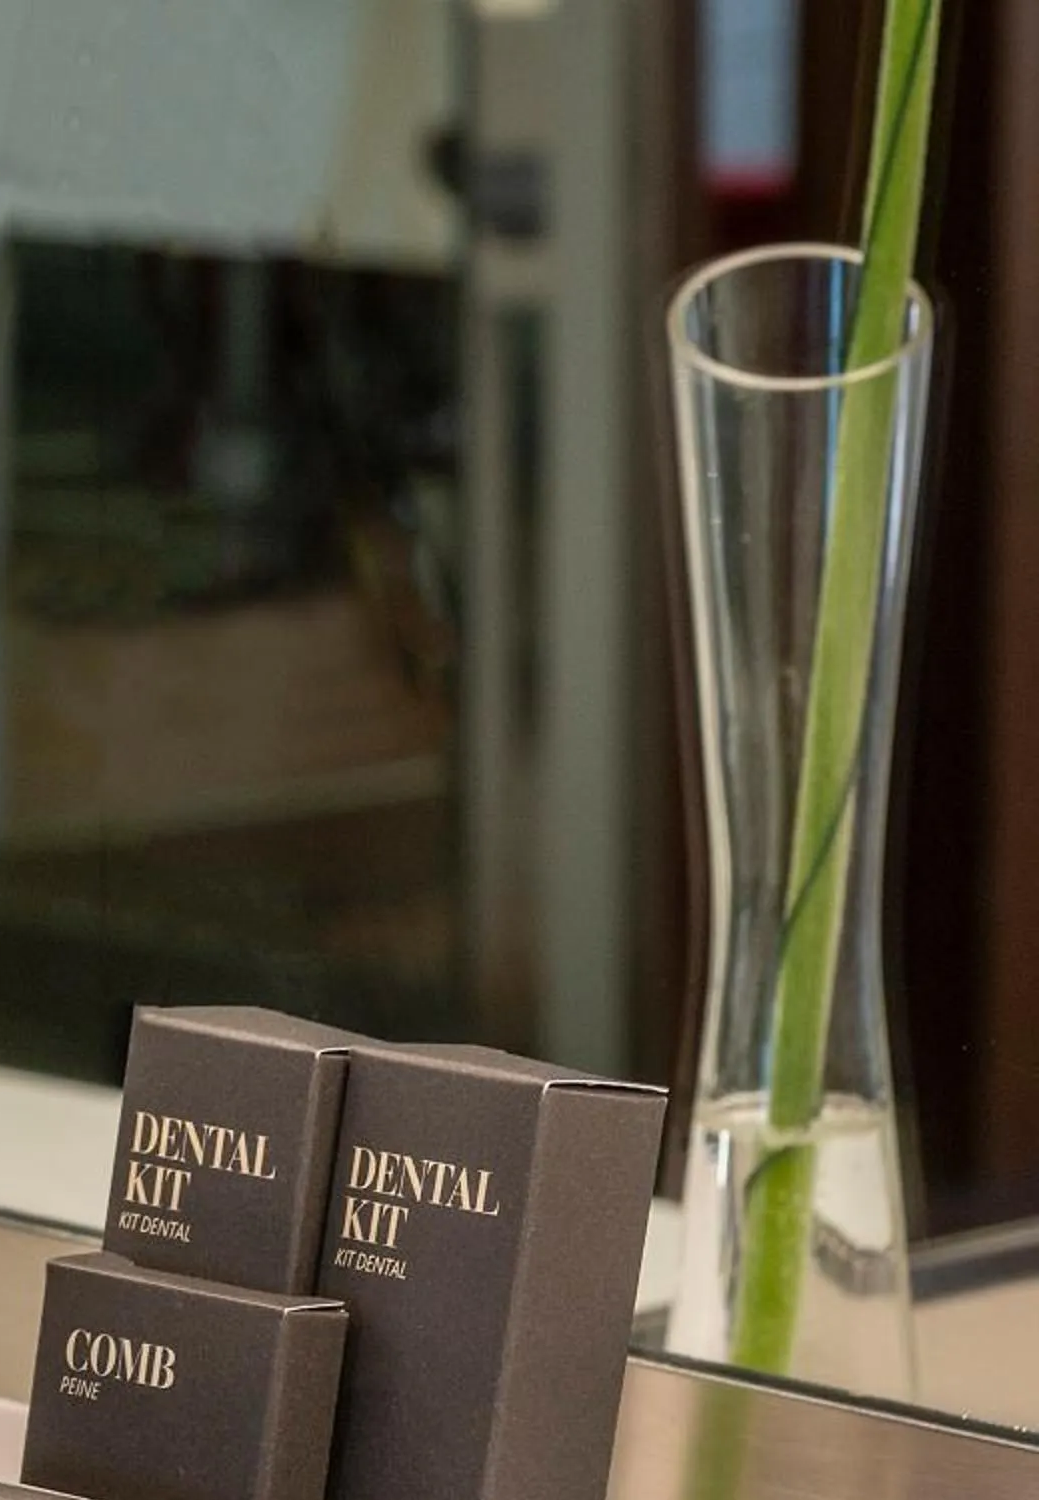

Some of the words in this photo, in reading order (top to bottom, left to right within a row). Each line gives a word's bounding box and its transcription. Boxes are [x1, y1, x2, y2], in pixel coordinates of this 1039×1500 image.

[129, 1110, 276, 1180] DENTAL
[124, 1161, 192, 1212] KIT
[348, 1144, 499, 1216] DENTAL
[118, 1210, 141, 1231] KIT
[140, 1215, 192, 1243] DENTAL
[339, 1196, 409, 1249] KIT
[334, 1247, 357, 1269] KIT
[355, 1251, 408, 1281] DENTAL
[65, 1327, 177, 1390] COMB
[59, 1375, 102, 1401] PEINE
